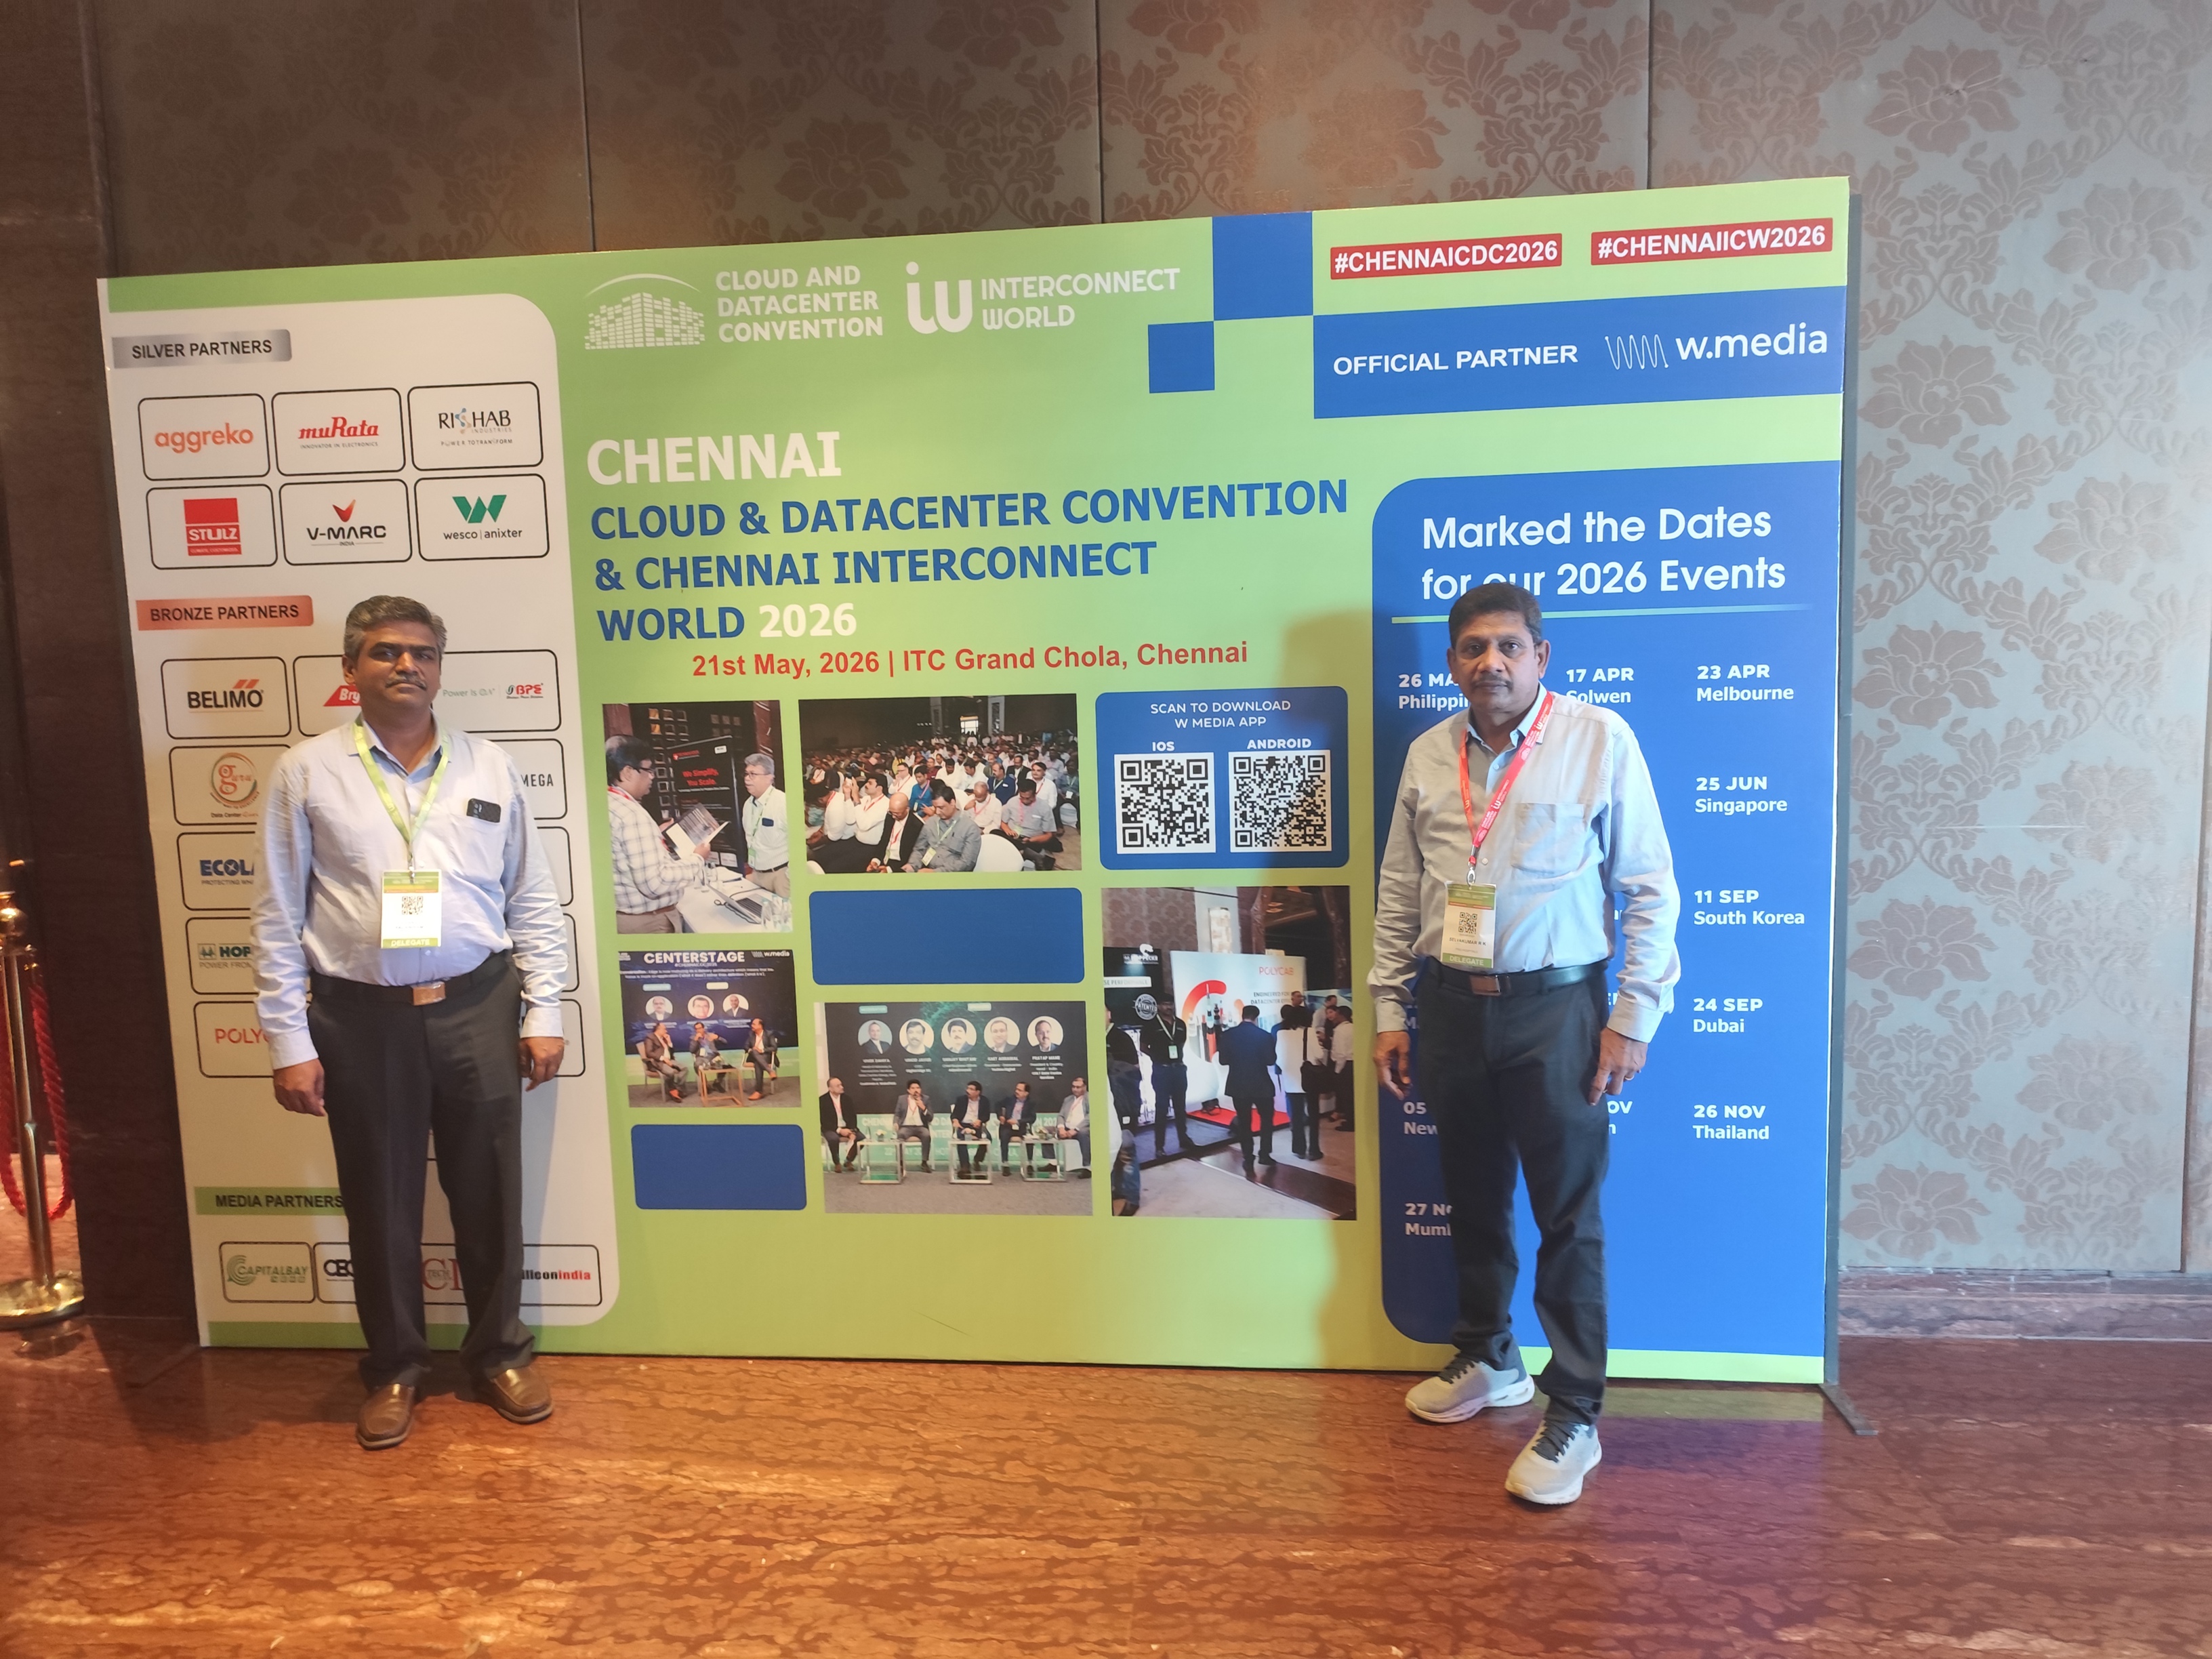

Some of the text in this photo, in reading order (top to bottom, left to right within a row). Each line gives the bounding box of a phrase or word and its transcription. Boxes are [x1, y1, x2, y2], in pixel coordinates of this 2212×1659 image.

[1598, 224, 1825, 258] #CHENNAIICW2026
[1334, 241, 1558, 273] #CHENNAICDC2026
[716, 265, 861, 291] CLOUD AND
[981, 268, 1181, 300] INTERCONNECT
[717, 291, 880, 317] DATACENTER
[982, 304, 1076, 330] WORLD
[718, 316, 883, 343] CONVENTION
[1675, 322, 1828, 360] w.media
[131, 340, 272, 359] SILVER PARTNERS
[1333, 345, 1578, 375] OFFICIAL PARTNER
[298, 417, 380, 439] muRata
[155, 422, 253, 453] aggreko
[587, 431, 842, 485] CHENNAI
[591, 478, 1347, 539] CLOUD & DATACENTER CONVENTION
[189, 527, 238, 541] STULZ
[306, 525, 387, 540] V-MARC
[443, 528, 523, 540] wesco anixter
[1422, 506, 1771, 550] Marked the Dates
[594, 541, 1157, 591] & CHENNAI INTERCONNECT
[1422, 568, 1471, 600] for
[1557, 560, 1647, 594] 2026
[1660, 556, 1786, 592] Events
[150, 604, 300, 621] BRONZE PARTNERS
[597, 602, 857, 641] WORLD 2026
[692, 654, 746, 676] 21st
[754, 653, 811, 680] May,
[819, 651, 880, 673] 2026
[903, 649, 945, 672] ITC
[955, 647, 1035, 670] Grand
[1044, 644, 1128, 670] Chola,
[1136, 640, 1248, 665] Chennai
[1565, 668, 1635, 682] 17 APR
[1696, 664, 1770, 680] 23 APR
[1398, 673, 1459, 688] 26 MA
[187, 689, 264, 709] BELIMO
[1696, 686, 1795, 701] Melbourne
[1150, 700, 1292, 714] SCAN TO DOWNLOAD
[1174, 716, 1267, 729] W MEDIA APP
[1246, 738, 1312, 750] ANDROID
[1696, 776, 1767, 792] 25 JUN
[1695, 798, 1788, 816] Singapore
[1694, 889, 1759, 903] 11 SEP
[1694, 910, 1805, 925] South Korea
[391, 939, 430, 947] DELEGATE
[643, 951, 745, 964] CENTERSTAGE
[1450, 953, 1485, 966] DELEGATE
[1258, 966, 1294, 976] POLYCAB
[1693, 998, 1763, 1012] 24 SEP
[1693, 1018, 1745, 1033] Dubai
[1403, 1101, 1427, 1115] 05
[1607, 1100, 1633, 1114] OV
[1693, 1104, 1766, 1119] 26 NOV
[1692, 1124, 1769, 1140] Thailand
[216, 1195, 344, 1208] MEDIA PARTNERS
[1404, 1203, 1428, 1216] 27
[521, 1269, 592, 1280] iliconindia
